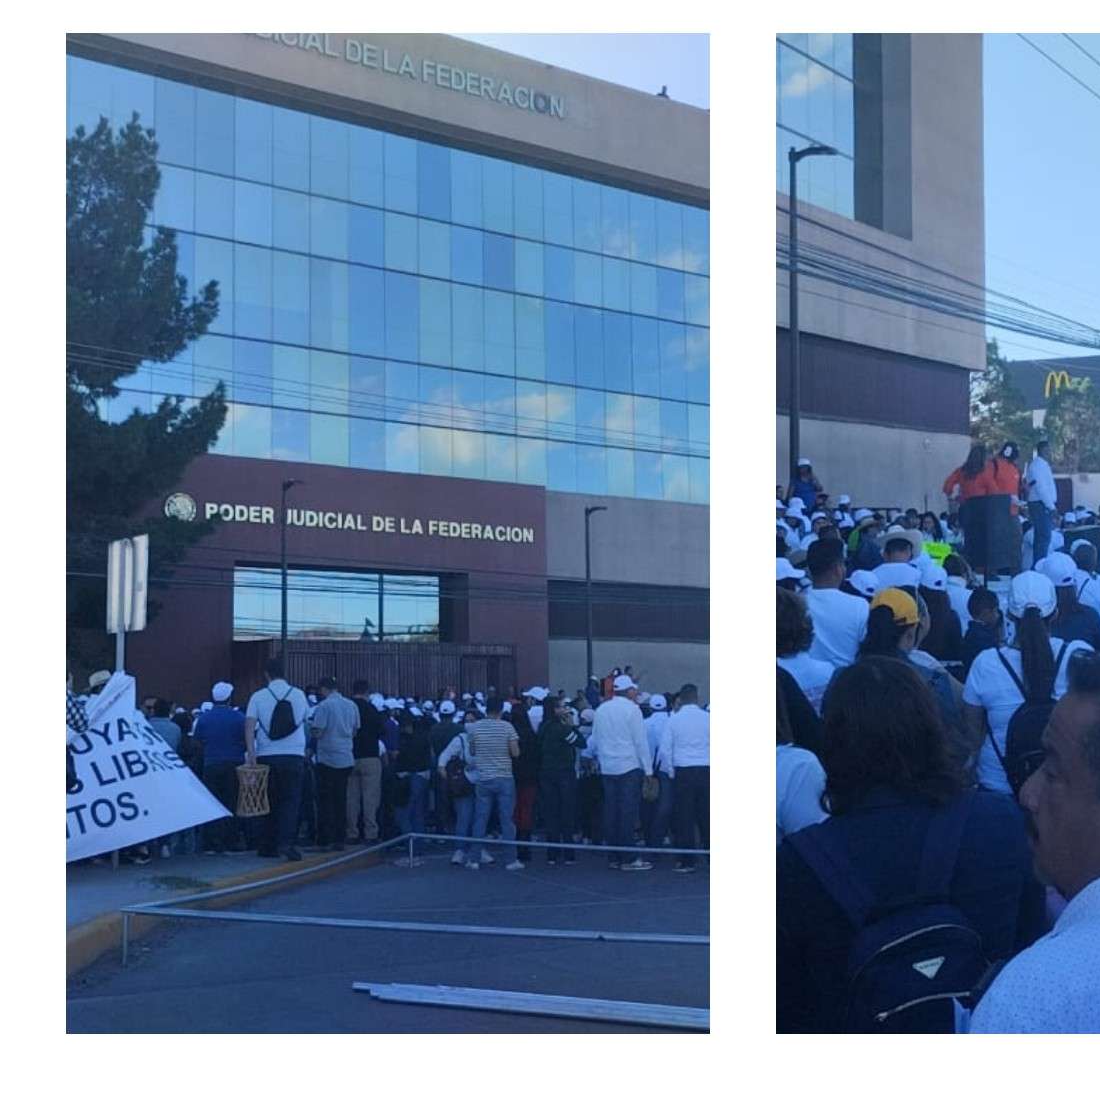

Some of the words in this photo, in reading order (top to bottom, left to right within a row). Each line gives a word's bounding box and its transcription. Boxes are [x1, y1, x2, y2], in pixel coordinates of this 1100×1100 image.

[345, 38, 378, 68] DE
[383, 49, 416, 80] LA
[421, 59, 566, 119] FEDERACION
[205, 502, 275, 525] PODER
[286, 508, 367, 531] JUDICIAL
[372, 515, 396, 533] DE
[400, 518, 423, 535] LA
[428, 520, 534, 543] FEDERACION
